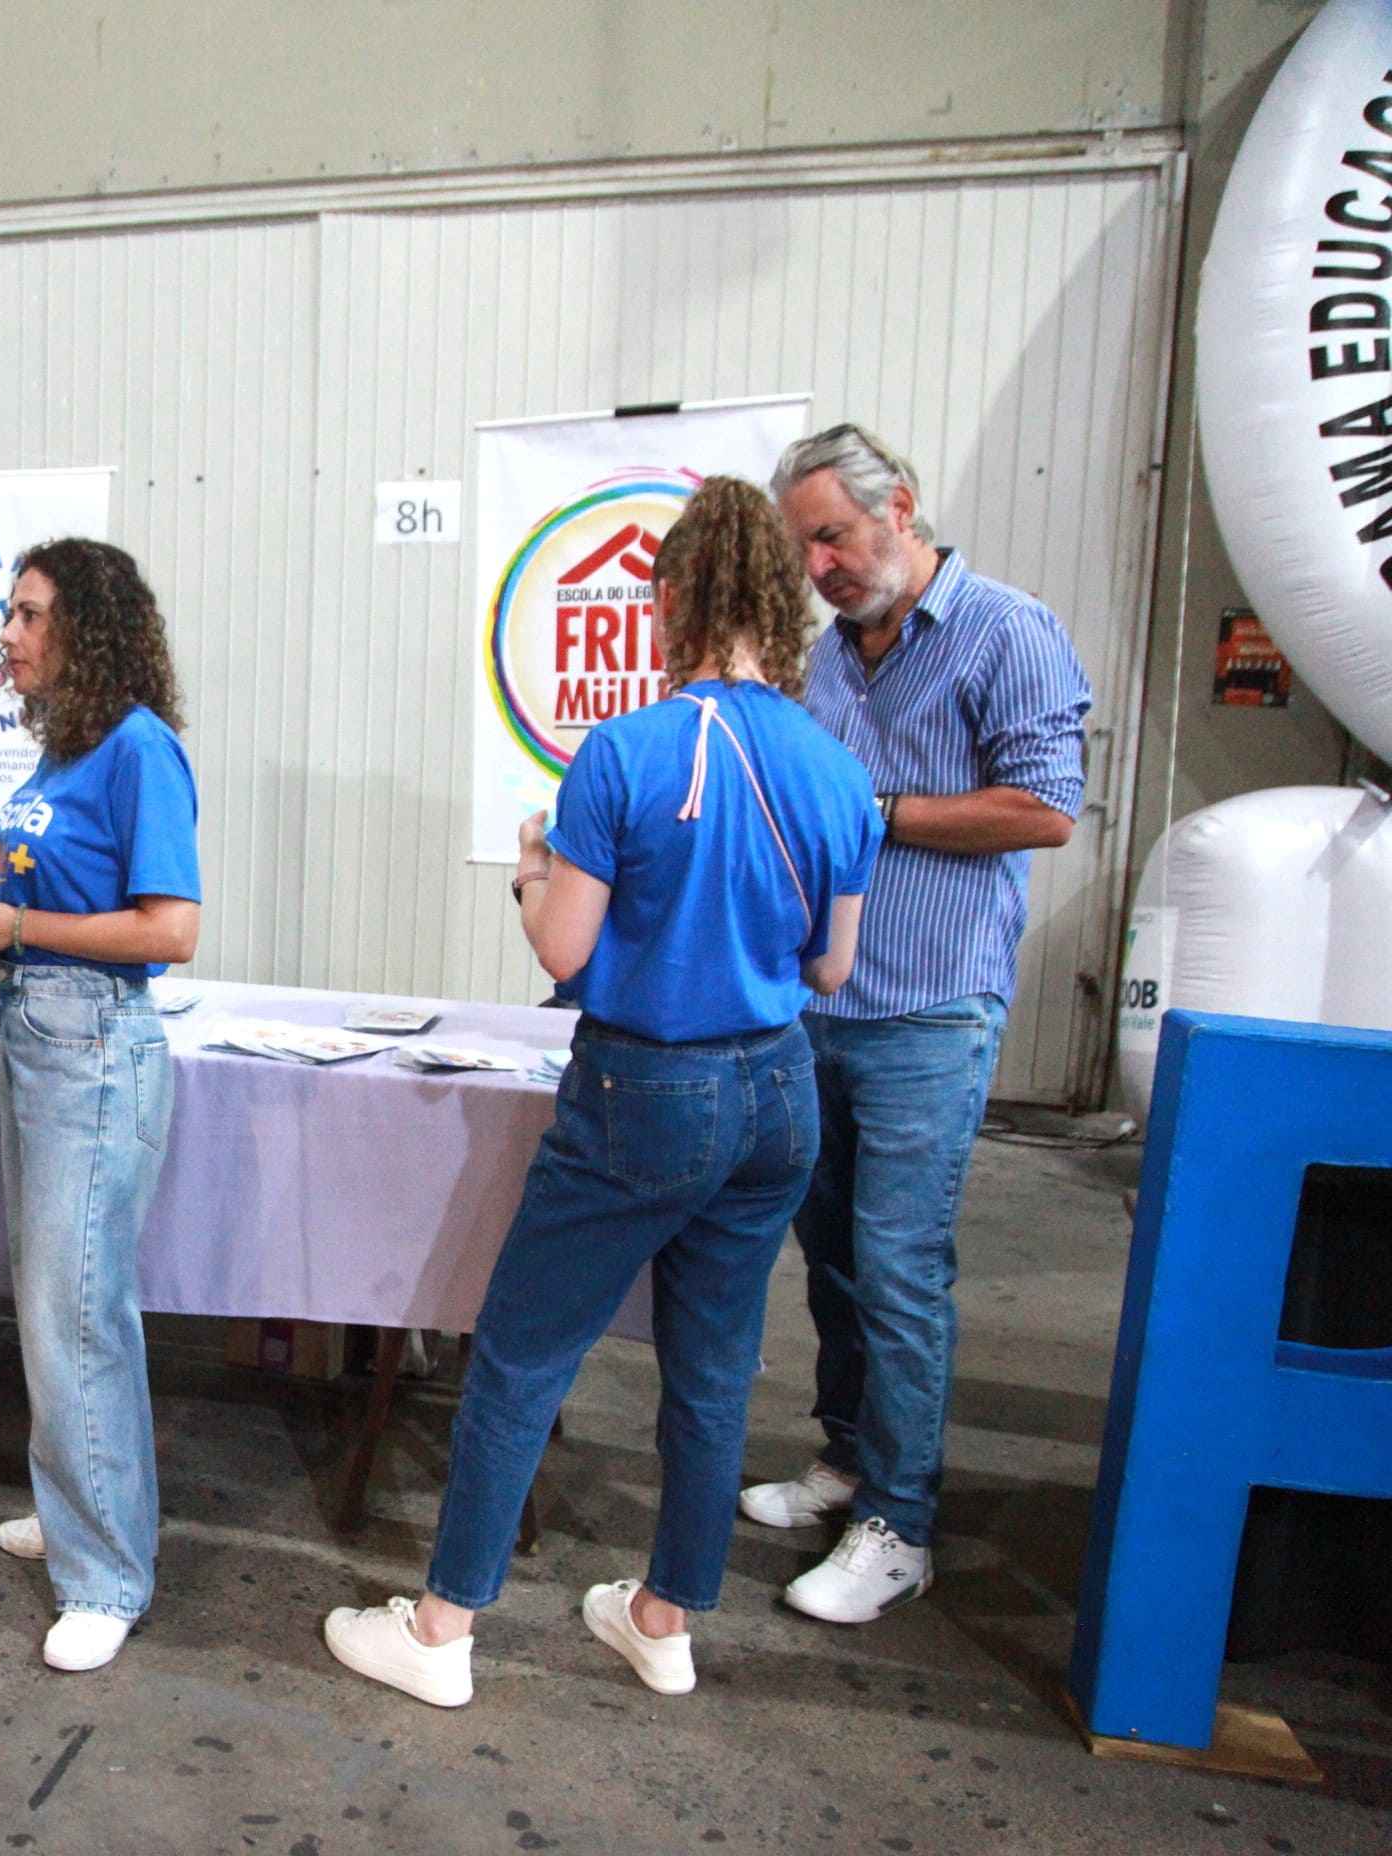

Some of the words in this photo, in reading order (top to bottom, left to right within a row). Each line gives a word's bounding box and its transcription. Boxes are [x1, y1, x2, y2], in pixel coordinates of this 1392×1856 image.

[396, 498, 442, 534] 8h
[557, 587, 603, 602] ESCOLA
[606, 585, 624, 600] DO
